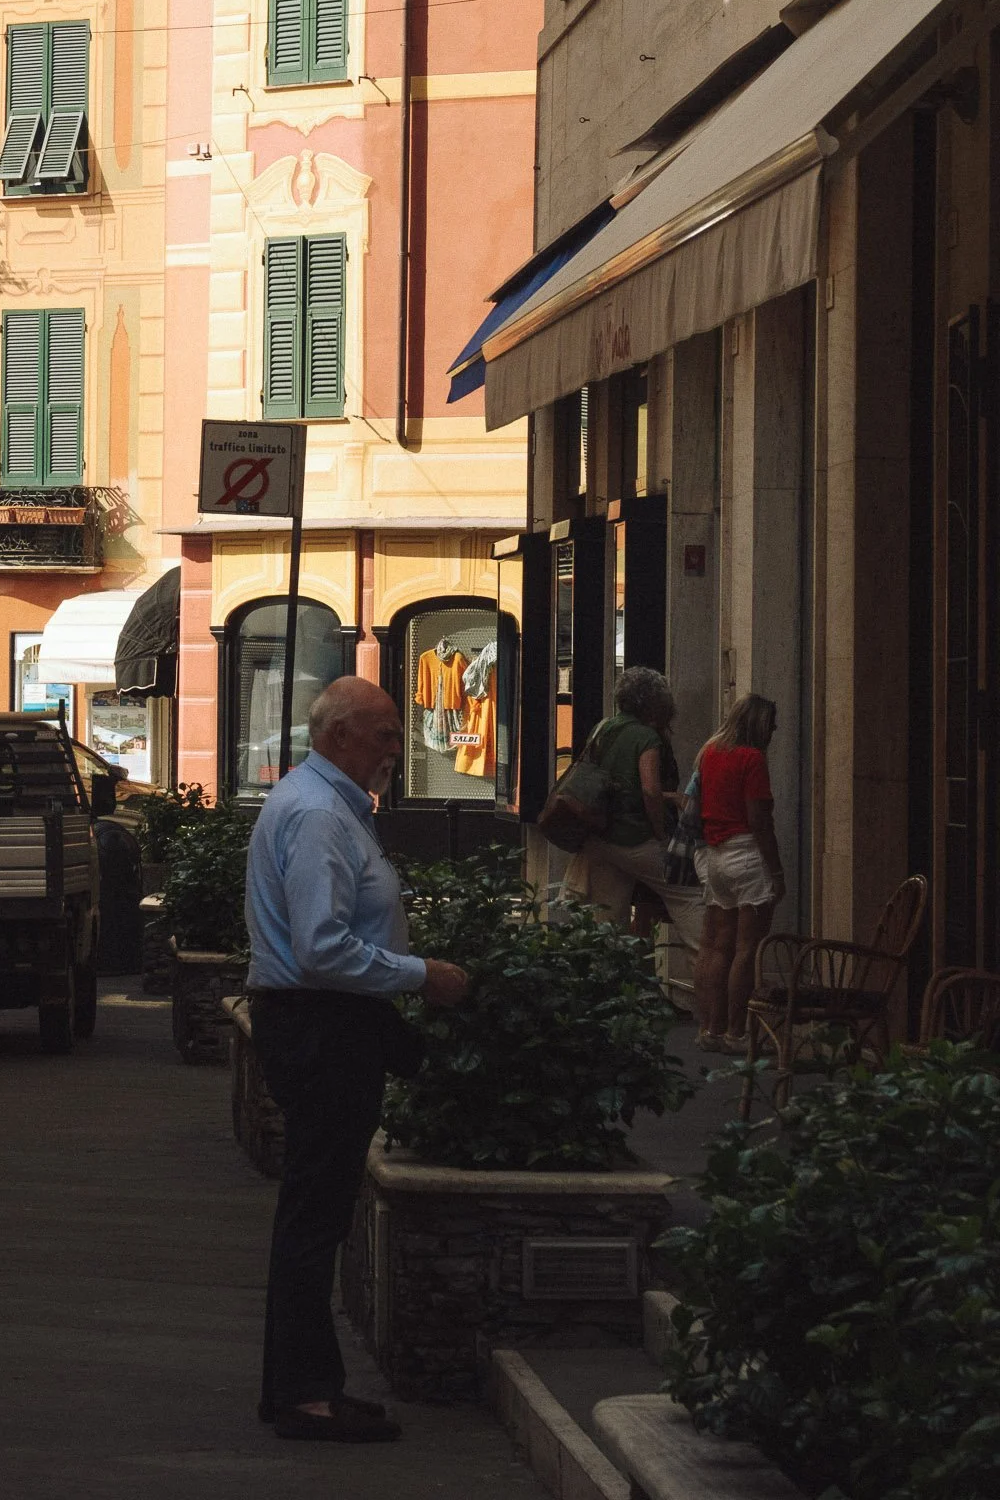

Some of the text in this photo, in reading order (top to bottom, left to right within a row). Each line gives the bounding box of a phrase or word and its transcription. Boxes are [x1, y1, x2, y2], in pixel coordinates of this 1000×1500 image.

[238, 430, 259, 439] zona
[209, 441, 287, 455] traffico limitato
[453, 735, 478, 743] SALDI
